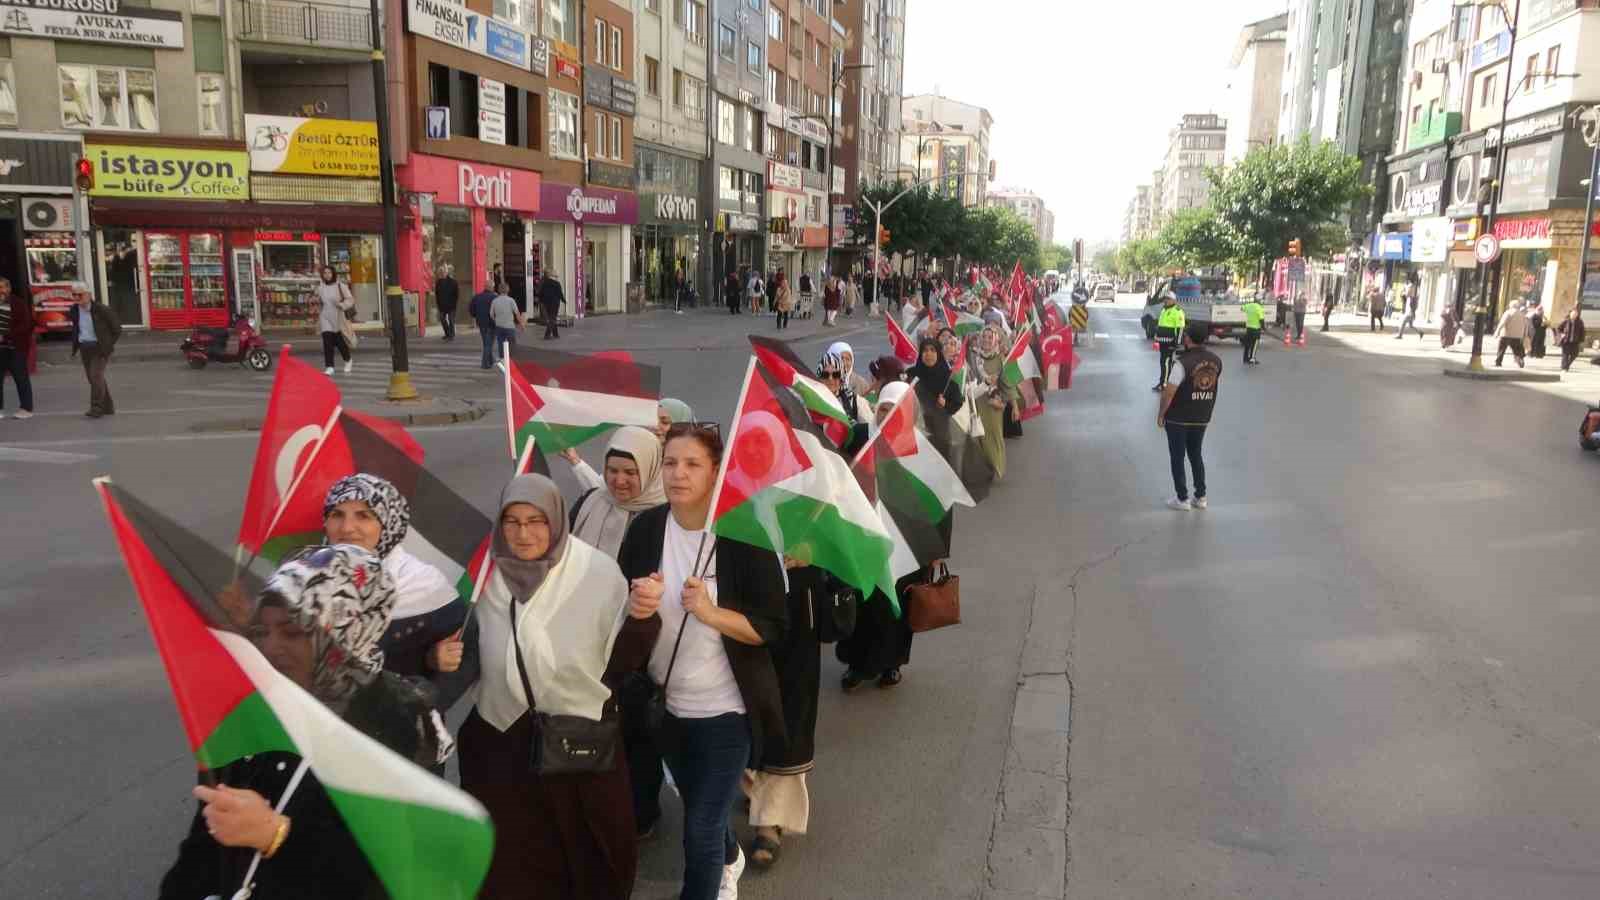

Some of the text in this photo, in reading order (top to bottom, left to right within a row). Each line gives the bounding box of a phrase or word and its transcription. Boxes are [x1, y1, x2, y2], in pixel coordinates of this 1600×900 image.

[75, 14, 134, 30] AVUKAT
[44, 25, 165, 44] FEYZA NUR ALSANCAK
[434, 21, 464, 44] EKSEN
[298, 132, 377, 147] Betül ÖZTÜR
[100, 150, 234, 190] istasyon
[123, 178, 241, 195] büfe Coffee
[459, 164, 512, 208] Penti
